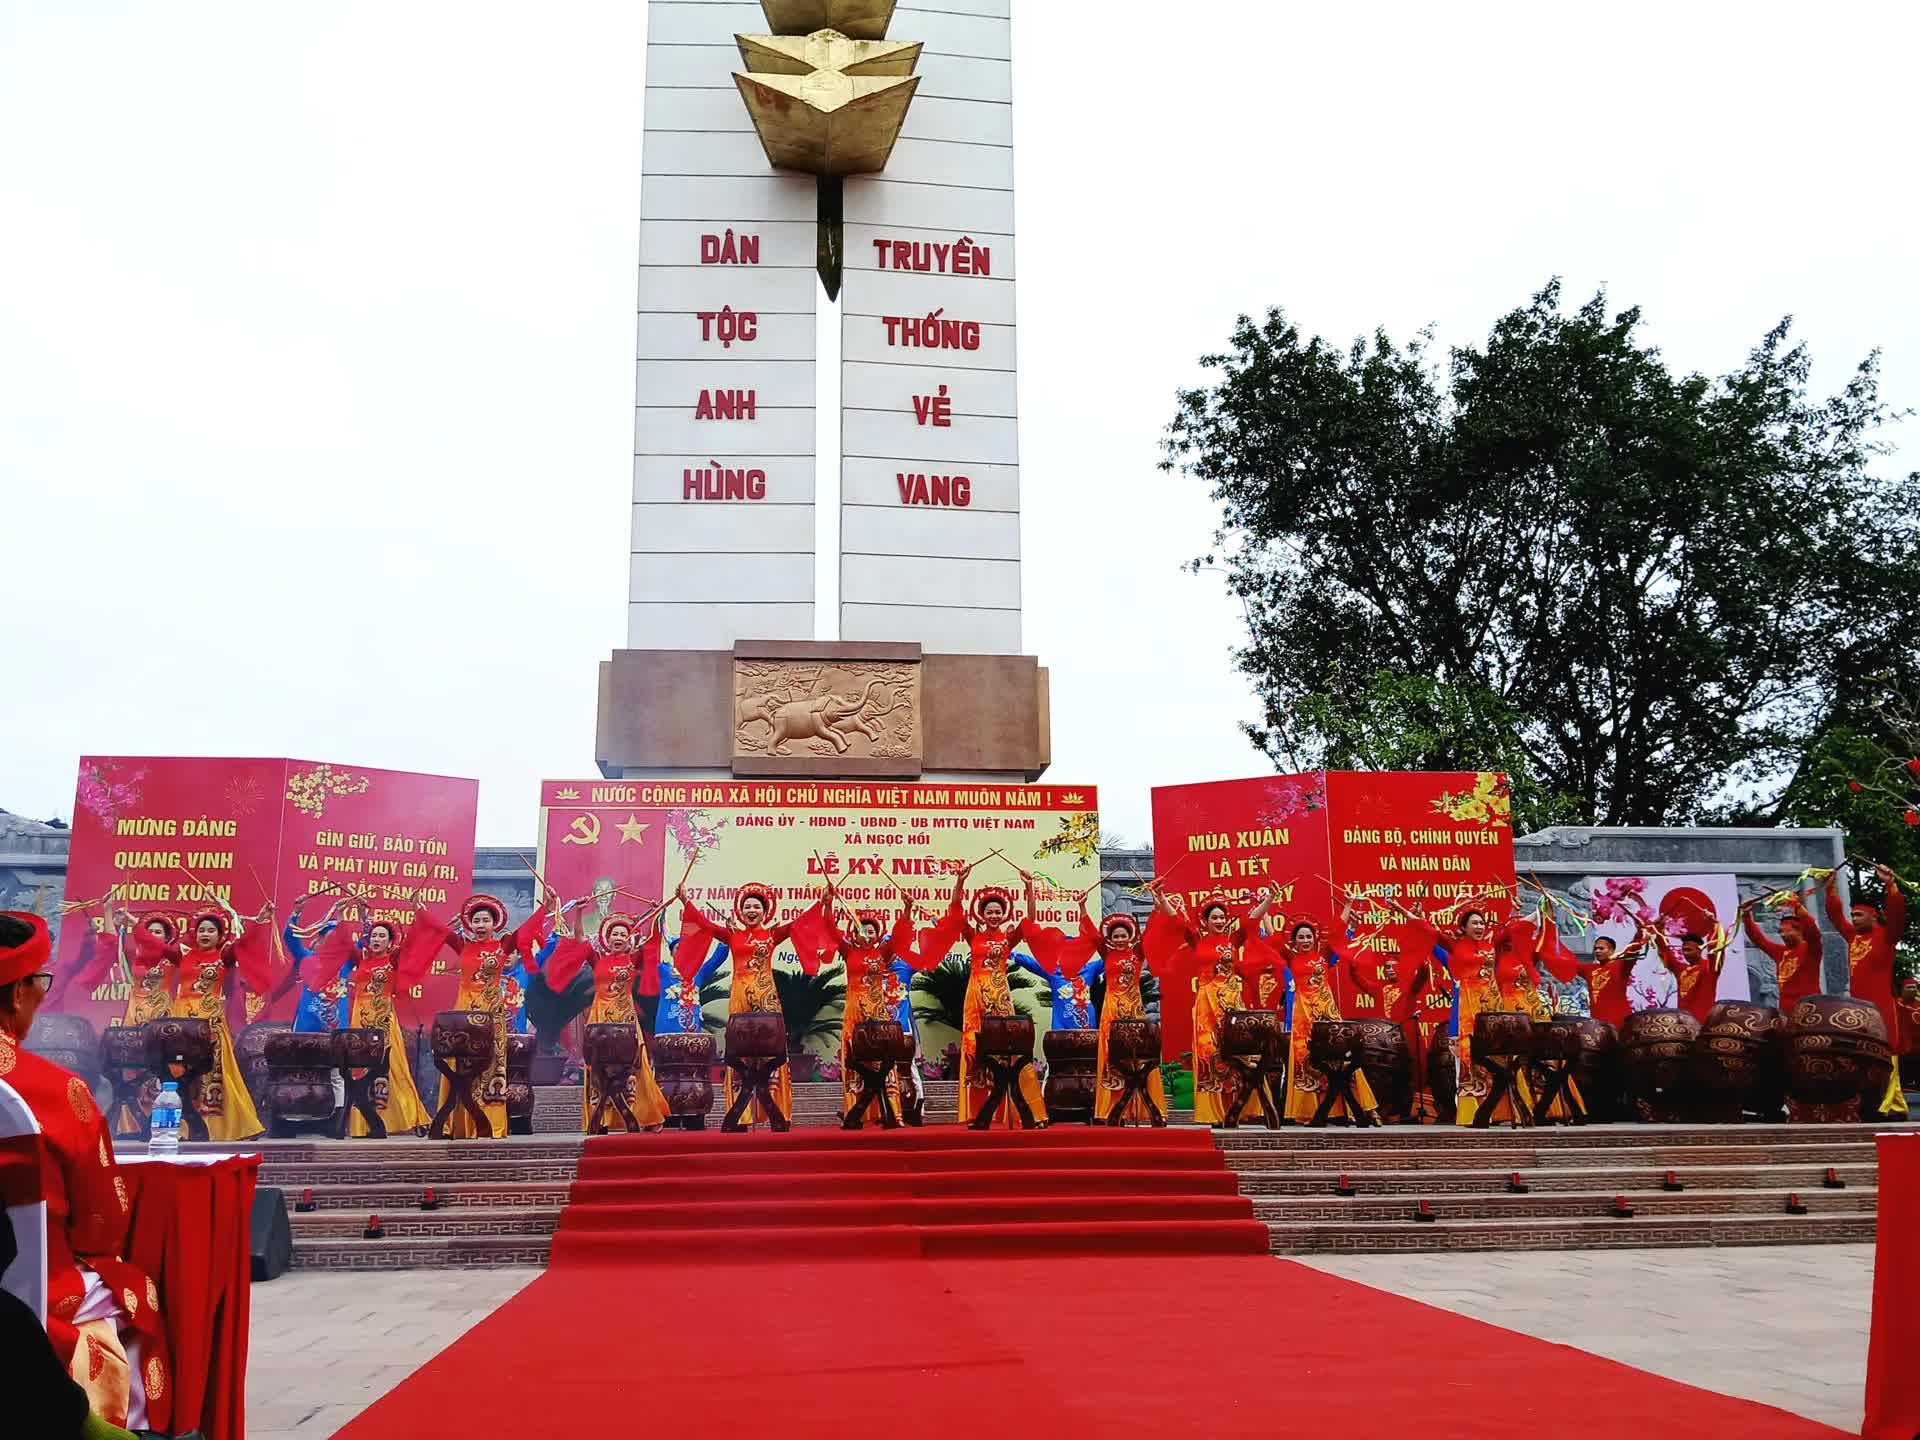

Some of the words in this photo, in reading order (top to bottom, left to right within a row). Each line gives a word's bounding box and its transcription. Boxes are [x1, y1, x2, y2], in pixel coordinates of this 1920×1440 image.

[701, 229, 759, 264] DÂN
[873, 236, 990, 275] TRUYỀN
[697, 305, 757, 348] TỘC
[882, 308, 980, 350] THỐNG
[695, 390, 755, 420] ANH
[912, 385, 951, 426] VẺ
[683, 460, 765, 500] HÙNG
[896, 473, 970, 507] VANG
[592, 785, 636, 803] NƯỚC
[642, 785, 686, 806] CỘNG
[691, 785, 723, 803] HÒA
[729, 785, 749, 803] XÃ
[755, 785, 781, 806] HỘI
[787, 784, 818, 803] CHỦ
[823, 786, 871, 804] NGHĨA
[876, 787, 909, 807] VIỆT
[913, 790, 949, 805] NAM
[954, 788, 1000, 806] MUÔN
[1005, 788, 1041, 806] NĂM
[117, 816, 177, 836] MỪNG
[182, 815, 237, 837] ĐẢNG
[736, 813, 773, 827] ĐẢNG
[860, 817, 897, 828] UBND
[911, 817, 928, 828] UB
[933, 818, 968, 829] MTTQ
[972, 817, 1000, 830] VIỆT
[1004, 818, 1035, 829] NAM
[316, 829, 344, 847] GÌN
[383, 834, 414, 853] BẢO
[866, 834, 903, 847] NGỌC
[1188, 831, 1231, 852] MÙA
[1236, 826, 1290, 848] XUÂN
[1343, 825, 1381, 844] ĐẢNG
[1410, 828, 1451, 844] CHÍNH
[114, 851, 181, 870] QUANG
[187, 852, 233, 869] VINH
[298, 852, 319, 870] VÀ
[323, 855, 364, 873] PHÁT
[368, 860, 399, 875] HUY
[403, 861, 428, 878] GIÁ
[807, 852, 840, 875] LỄ
[849, 853, 884, 875] KỶ
[1209, 858, 1233, 878] LÀ
[1237, 854, 1270, 876] TẾT
[1380, 854, 1397, 870] VÀ
[1401, 854, 1439, 871] NHÂN
[1443, 855, 1471, 871] DÂN
[111, 881, 170, 901] MỪNG
[176, 881, 231, 901] XUÂN
[787, 883, 824, 900] THẮN
[934, 887, 969, 900] XUN
[1257, 885, 1294, 903] CY
[1034, 906, 1062, 922] UỐC
